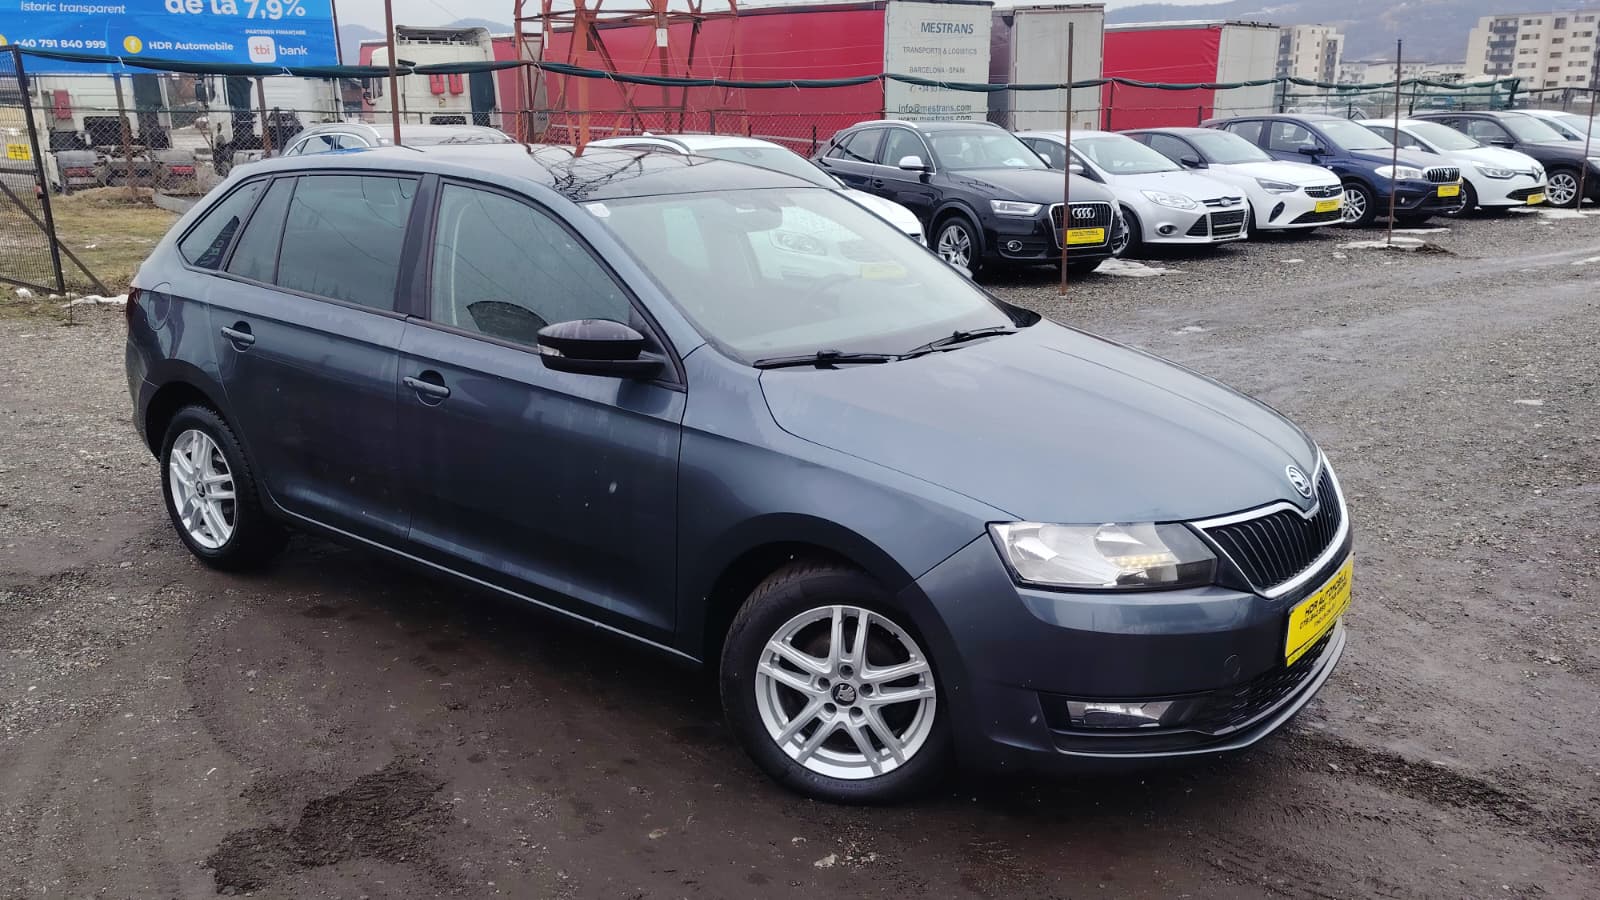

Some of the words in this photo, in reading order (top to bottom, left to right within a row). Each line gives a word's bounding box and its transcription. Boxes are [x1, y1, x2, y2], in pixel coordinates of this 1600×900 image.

[20, 1, 57, 12] Istoric
[59, 3, 126, 15] transparent
[920, 22, 975, 34] MESTRANS
[38, 40, 58, 48] 791
[60, 40, 83, 49] 840
[85, 40, 107, 49] 999
[149, 41, 172, 50] HDR
[174, 42, 234, 51] Automobile
[254, 45, 270, 55] tbi
[279, 45, 308, 56] bank
[909, 66, 945, 74] BARCELONA
[898, 104, 972, 113] info@mestrans.com
